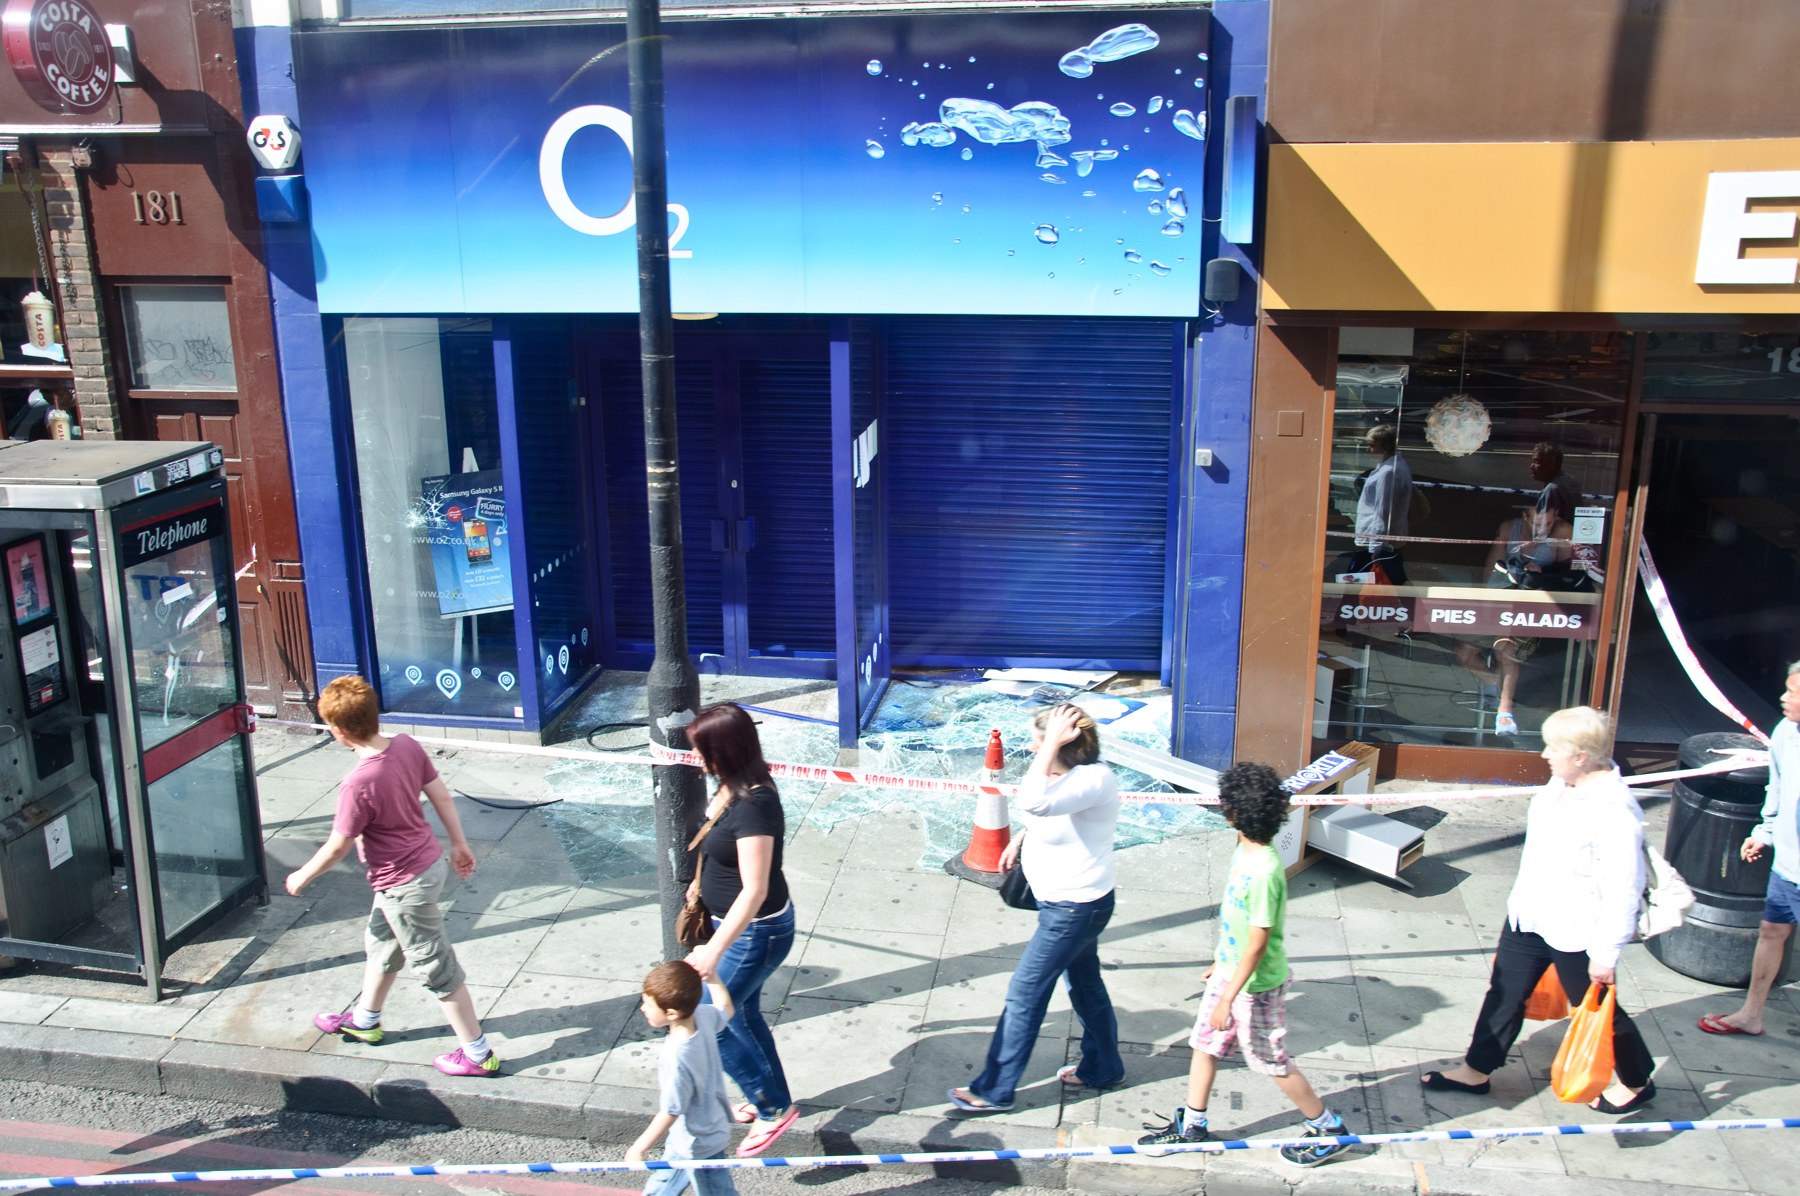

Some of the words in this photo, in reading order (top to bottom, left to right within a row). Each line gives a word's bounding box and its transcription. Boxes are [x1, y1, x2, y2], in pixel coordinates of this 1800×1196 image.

[40, 1, 91, 34] COSTA
[47, 63, 107, 102] COFFEE
[130, 190, 182, 222] 181
[35, 313, 45, 347] COSTA
[440, 490, 470, 498] Samsung
[480, 503, 505, 511] HURRY
[137, 518, 207, 555] Telephone
[1340, 604, 1409, 622] SOUPS
[1431, 608, 1477, 625] PIES
[1499, 611, 1582, 629] SALADS
